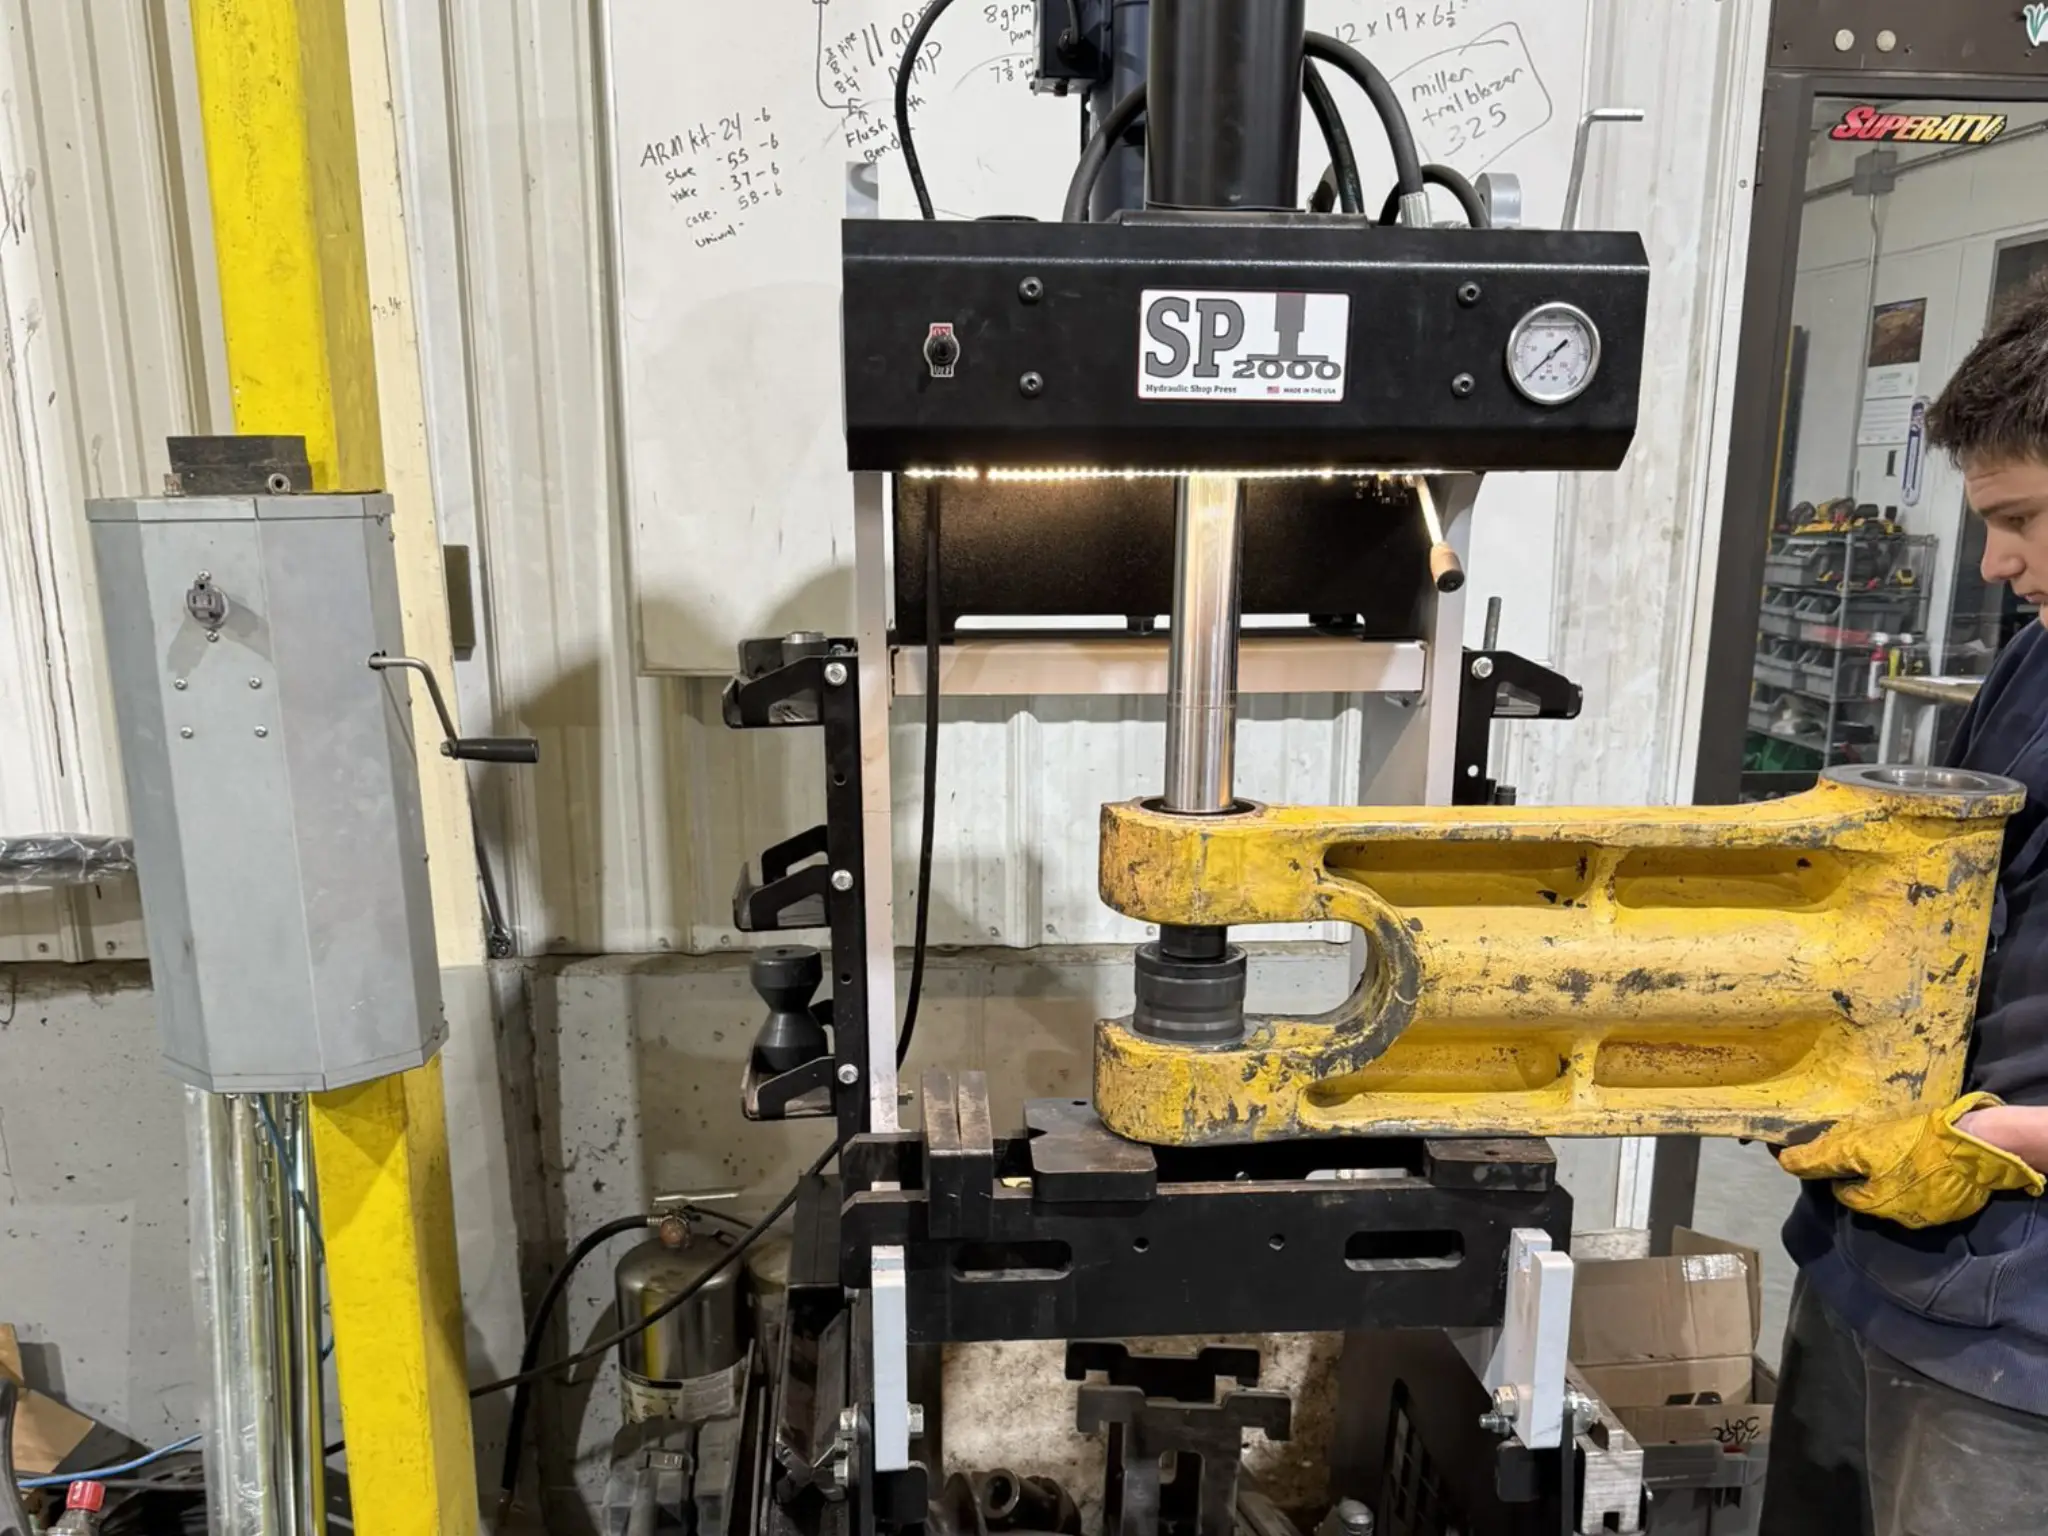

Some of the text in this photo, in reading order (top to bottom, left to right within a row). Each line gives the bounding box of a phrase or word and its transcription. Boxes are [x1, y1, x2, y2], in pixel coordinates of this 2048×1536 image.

[1335, 22, 1362, 44] 12
[1386, 5, 1408, 31] 19
[1411, 66, 1474, 102] miller
[845, 117, 889, 149] Flush
[1443, 103, 1507, 157] 325
[1831, 105, 2005, 143] SUPERATV
[1144, 295, 1246, 379] SP
[1231, 359, 1342, 381] 2000
[1145, 383, 1237, 395] Hydraulic Shop Press
